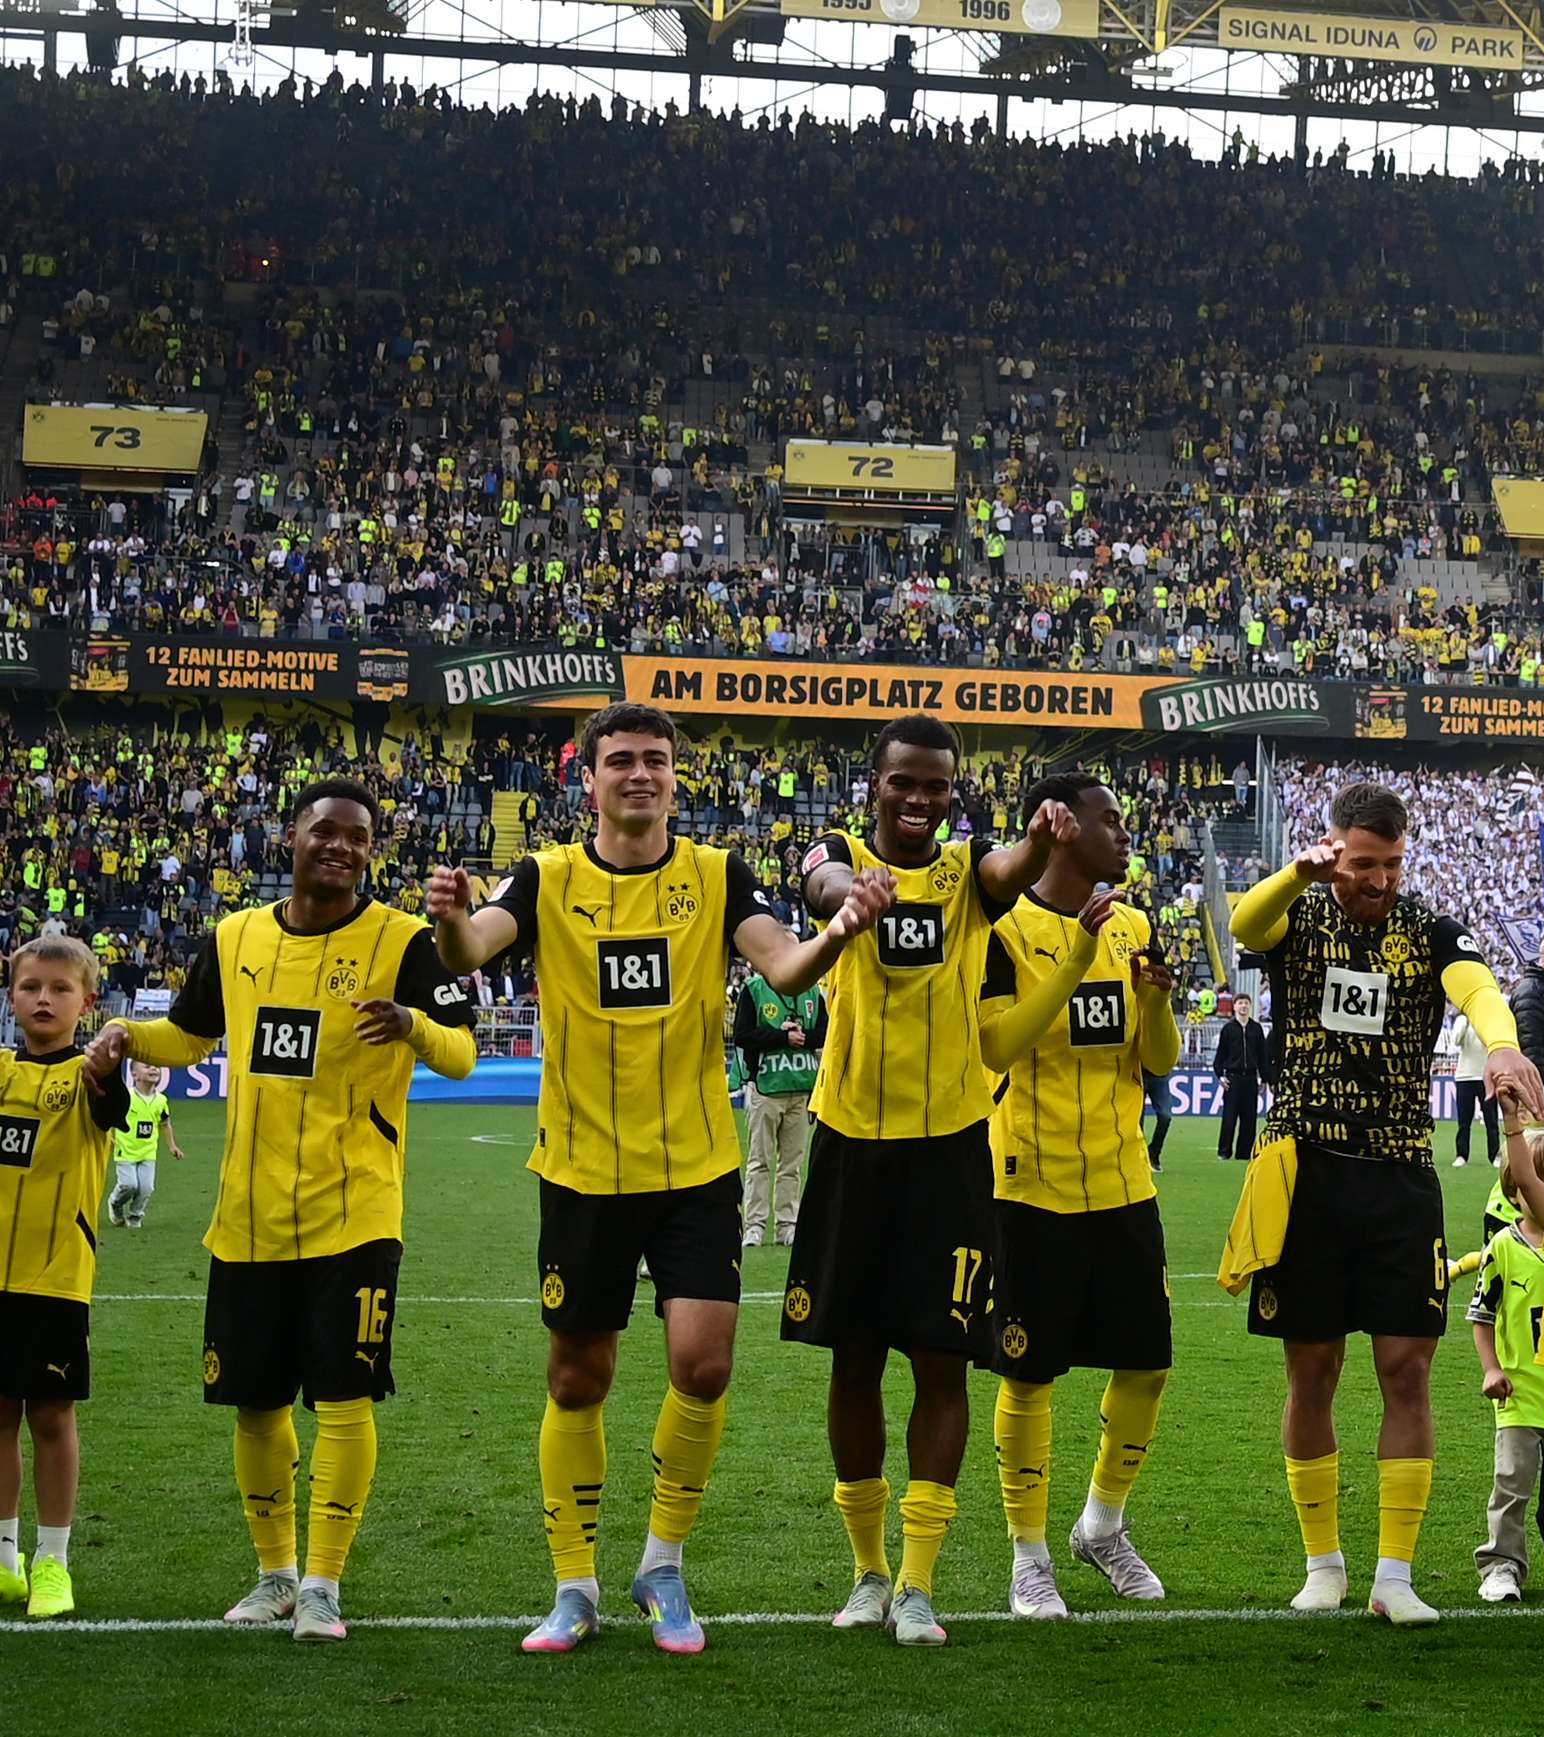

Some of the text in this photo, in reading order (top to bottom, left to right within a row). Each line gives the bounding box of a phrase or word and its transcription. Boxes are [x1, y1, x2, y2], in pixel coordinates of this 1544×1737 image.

[960, 0, 1010, 21] 1996
[1228, 18, 1515, 59] SIGNAL IDUNA PARK
[90, 425, 141, 449] 73
[848, 455, 894, 478] 72
[146, 646, 339, 672] 12 FANLIED-MOTIVE
[166, 667, 315, 692] ZUM SAMMELN
[651, 669, 1113, 716] AM BORSIGPLATZ GEBOREN
[1421, 695, 1443, 715] 12
[1439, 715, 1479, 735] ZUM
[935, 872, 960, 891] BVB
[670, 896, 696, 916] BVB
[883, 916, 936, 949] 1&1
[1385, 937, 1409, 954] BVB
[604, 953, 662, 990] 1&1
[1072, 995, 1119, 1029] 1&1
[1330, 982, 1380, 1017] 1&1
[261, 1022, 312, 1060] 1&1
[46, 1089, 68, 1106] BVB
[0, 1126, 32, 1155] &1
[952, 1247, 982, 1304] 17
[1433, 1238, 1445, 1290] 6
[545, 1276, 562, 1298] BVB
[788, 1291, 807, 1312] BVB
[354, 1287, 388, 1343] 16
[1005, 1328, 1025, 1349] BVB
